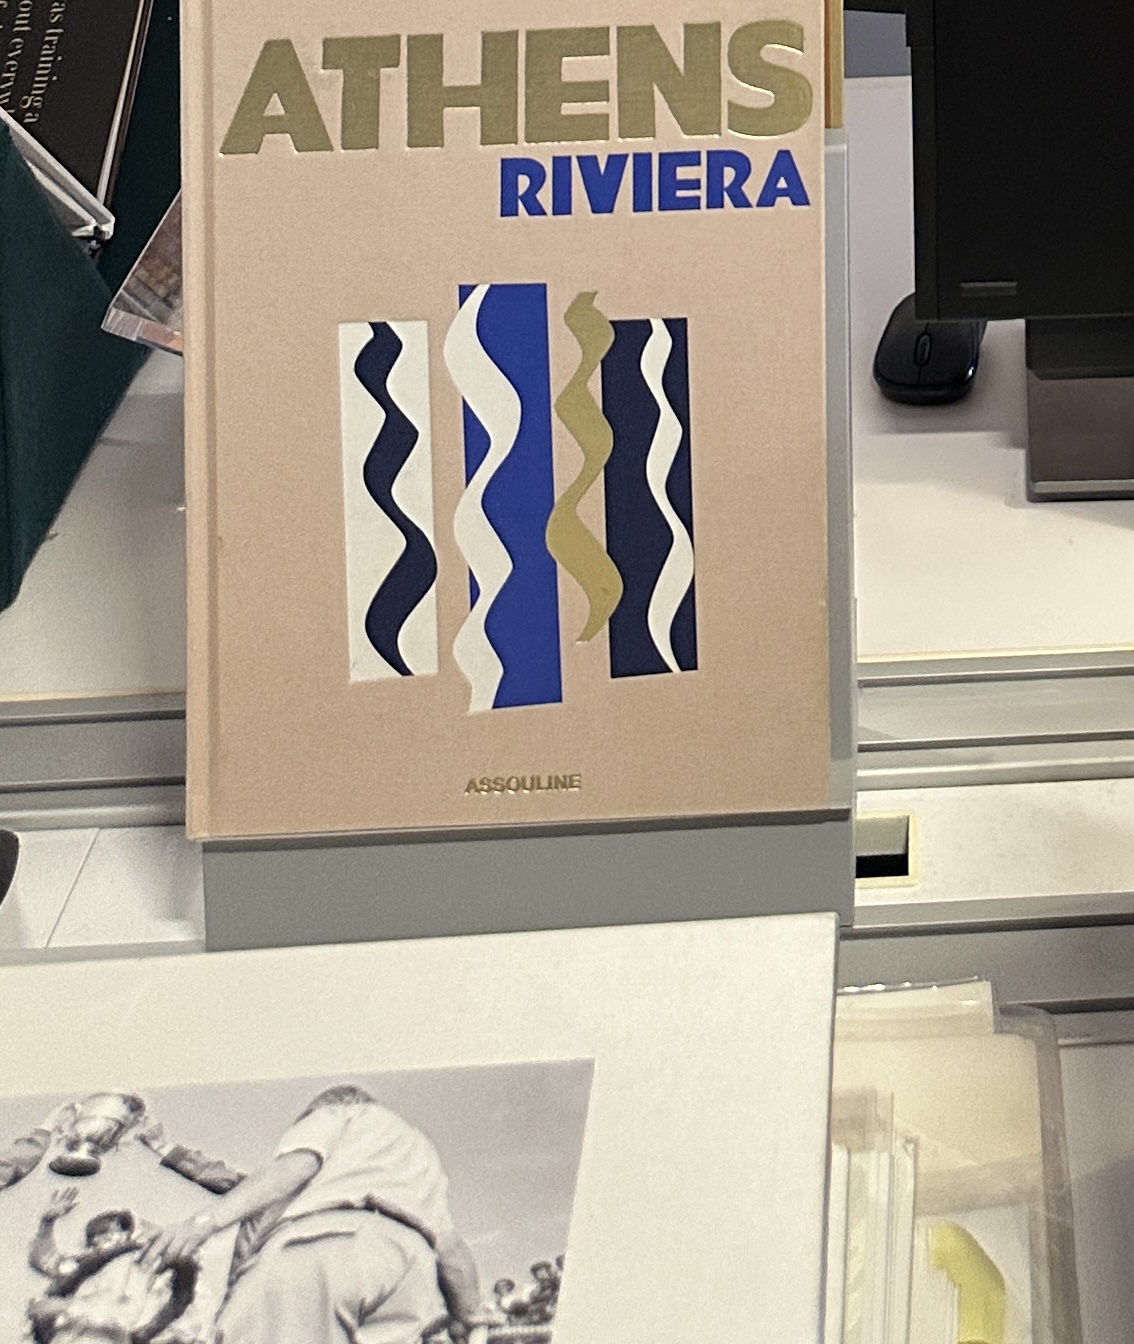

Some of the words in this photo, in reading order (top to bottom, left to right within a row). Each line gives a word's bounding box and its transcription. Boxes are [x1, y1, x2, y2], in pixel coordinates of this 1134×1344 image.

[0, 37, 25, 114] everyw
[20, 27, 65, 110] training
[218, 18, 815, 158] ATHENS
[22, 112, 40, 124] a
[499, 148, 812, 218] RIVIERA
[463, 772, 582, 796] ASSOULINE
